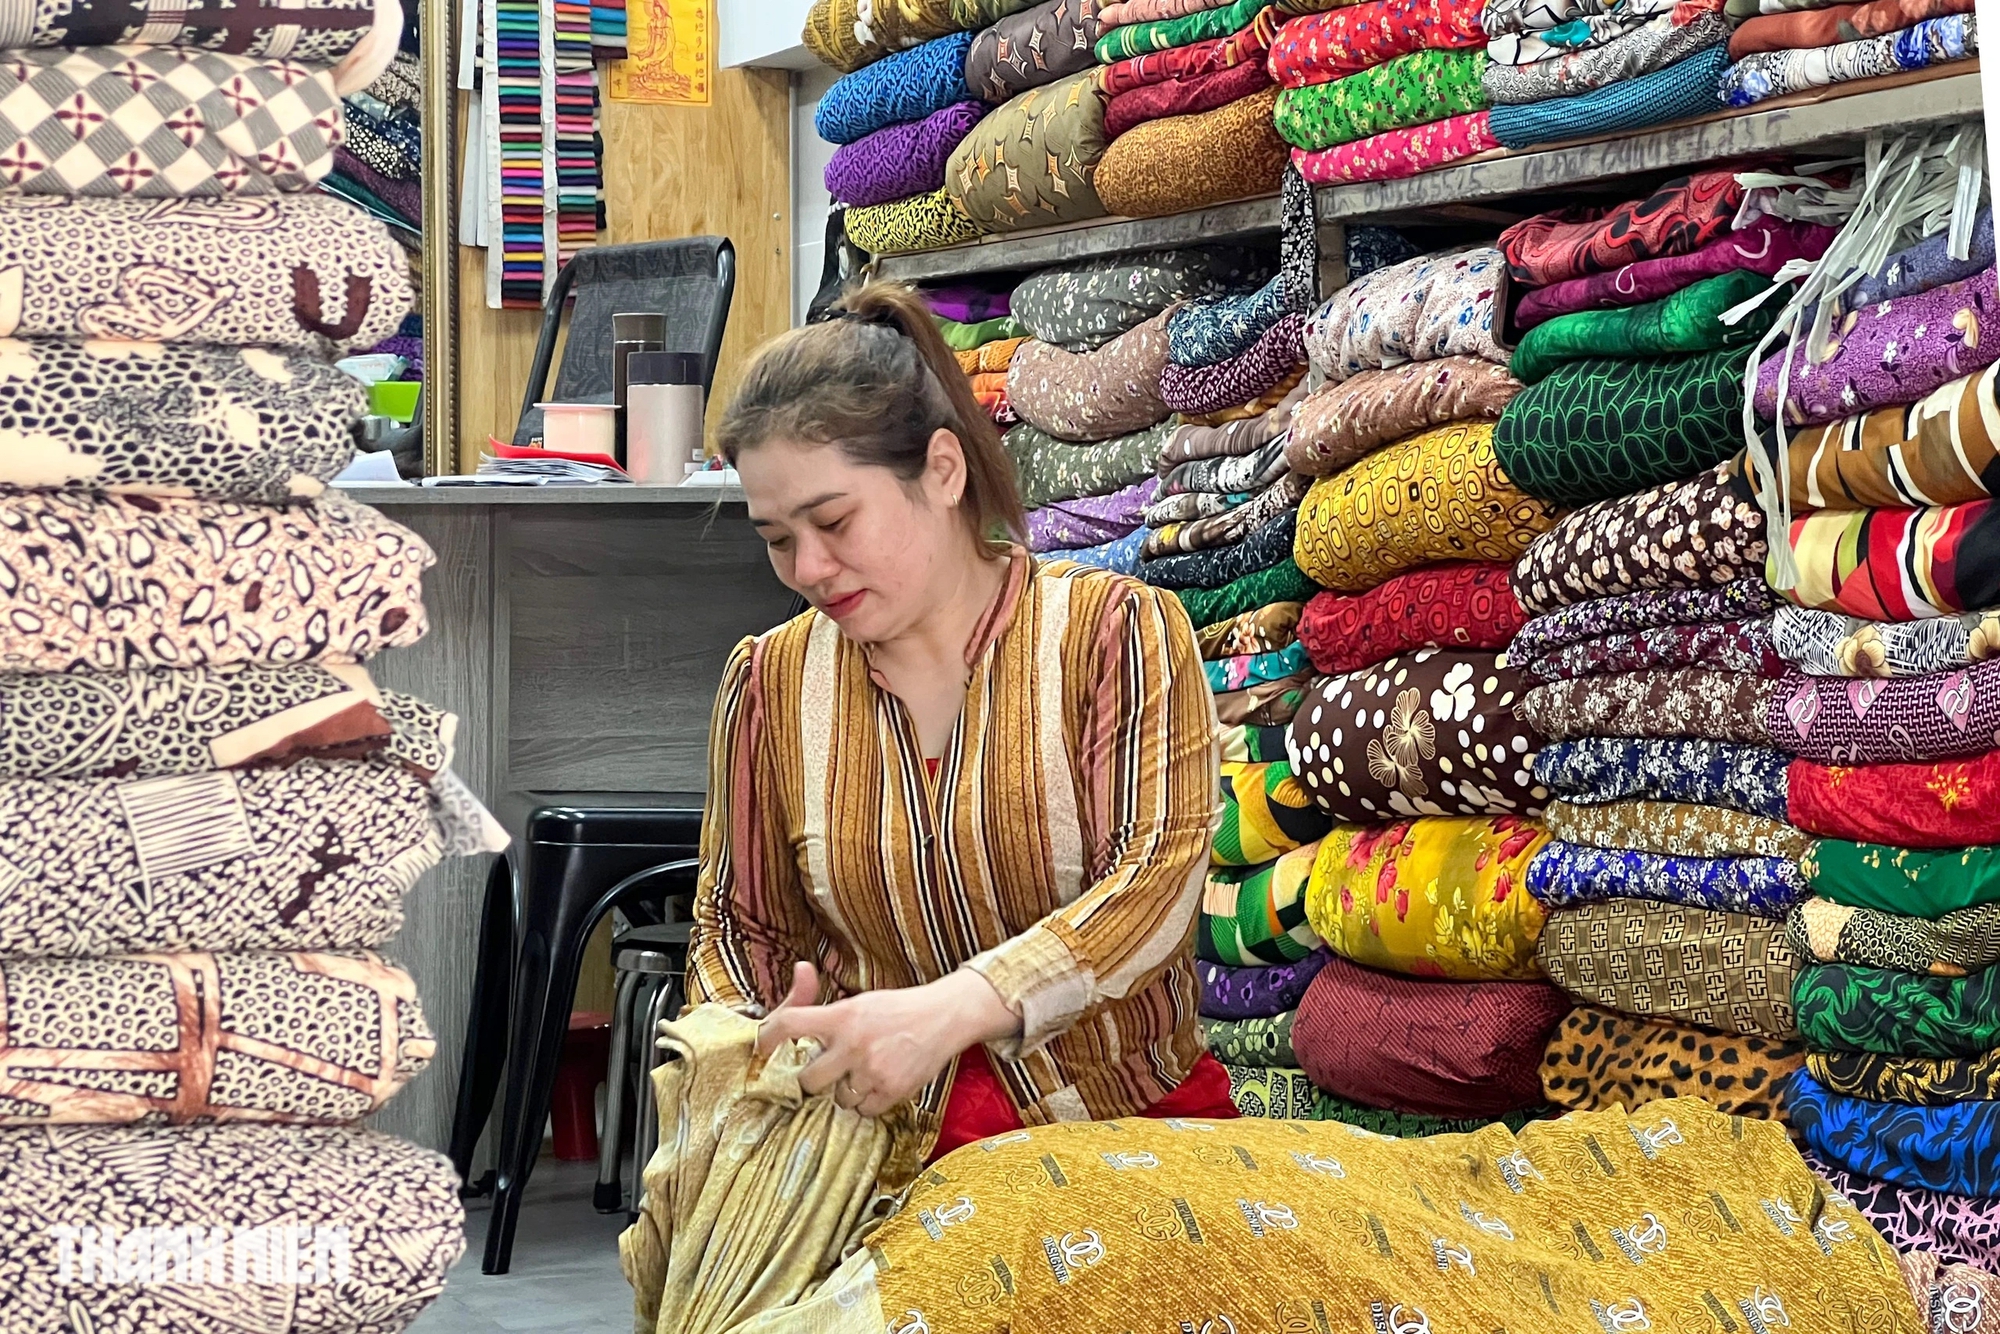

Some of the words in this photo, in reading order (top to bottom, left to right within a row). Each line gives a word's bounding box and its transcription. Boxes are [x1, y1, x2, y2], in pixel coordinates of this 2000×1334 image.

[1497, 1156, 1524, 1194] DESIGNER
[1042, 1236, 1068, 1284] DESIGNER
[1609, 1228, 1645, 1266] DESIGNER
